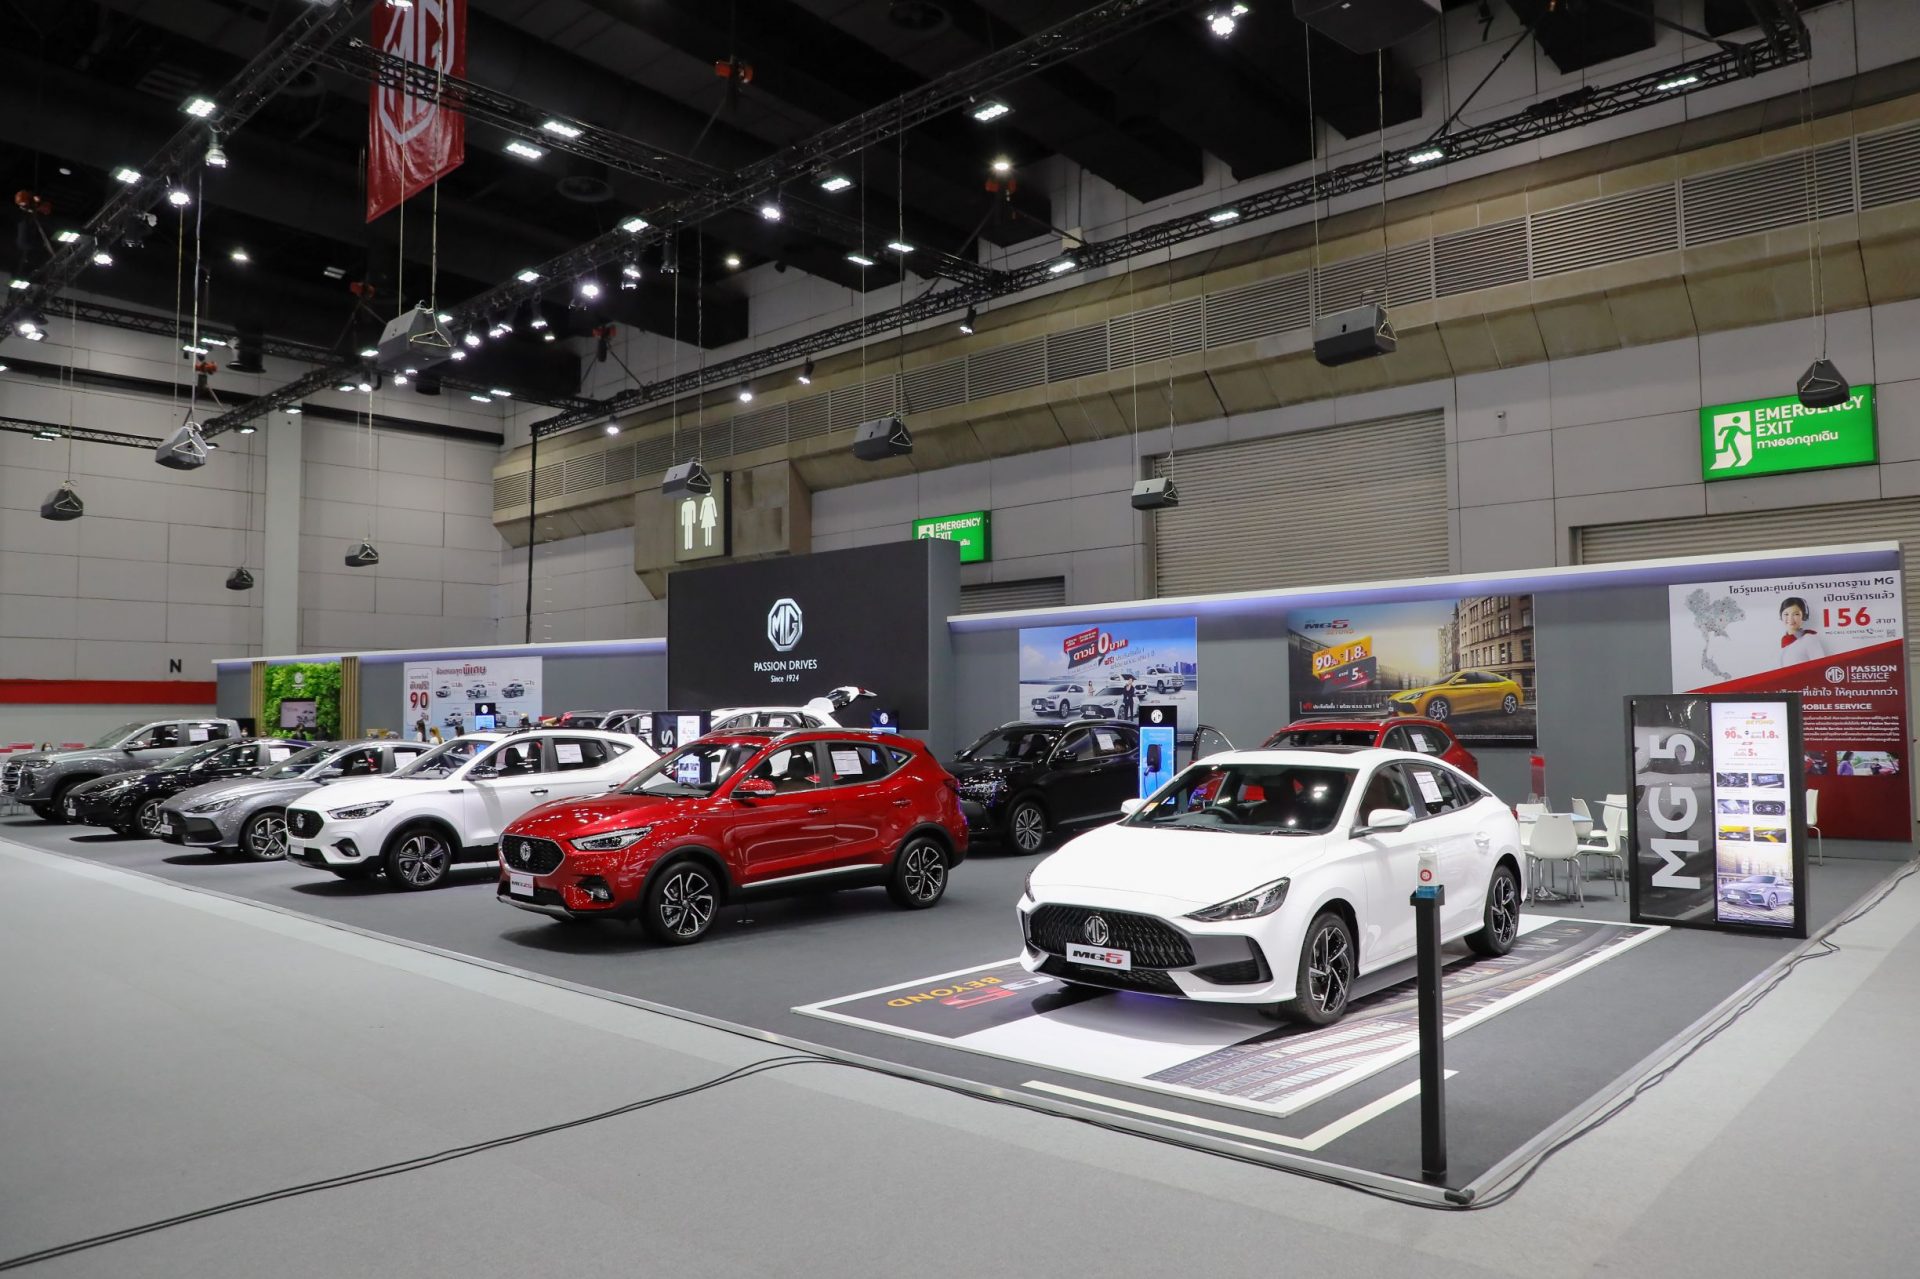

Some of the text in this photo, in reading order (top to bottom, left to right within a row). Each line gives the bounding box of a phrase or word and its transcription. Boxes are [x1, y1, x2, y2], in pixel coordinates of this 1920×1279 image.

[1756, 420, 1793, 437] EXIT
[1757, 430, 1838, 449] ทางออกฉุกเฉิน
[935, 517, 981, 532] EMERGENCY
[935, 531, 952, 540] EXIT
[1874, 576, 1894, 586] MG
[1823, 590, 1895, 602] เปิดบริการแล้ว
[770, 601, 801, 648] MG
[1304, 619, 1350, 629] MG5
[1823, 606, 1871, 628] 156
[1073, 642, 1095, 661] ดาวน์
[1097, 632, 1109, 654] 0
[1109, 638, 1126, 651] บาท
[170, 658, 182, 673] N
[753, 659, 818, 672] PASSION DRIVES
[1315, 654, 1332, 670] 90
[1850, 665, 1897, 673] PASSION
[770, 673, 800, 683] Since 1924
[1826, 667, 1844, 683] MG
[1851, 672, 1890, 680] SERVICE
[1835, 686, 1899, 698] ให้คุณมากกว่า
[410, 691, 429, 710] 90
[1724, 730, 1737, 739] 90
[1085, 917, 1107, 944] MG
[1072, 950, 1124, 965] MG5
[887, 976, 1004, 1008] BEYOND
[940, 976, 1055, 1010] G5
